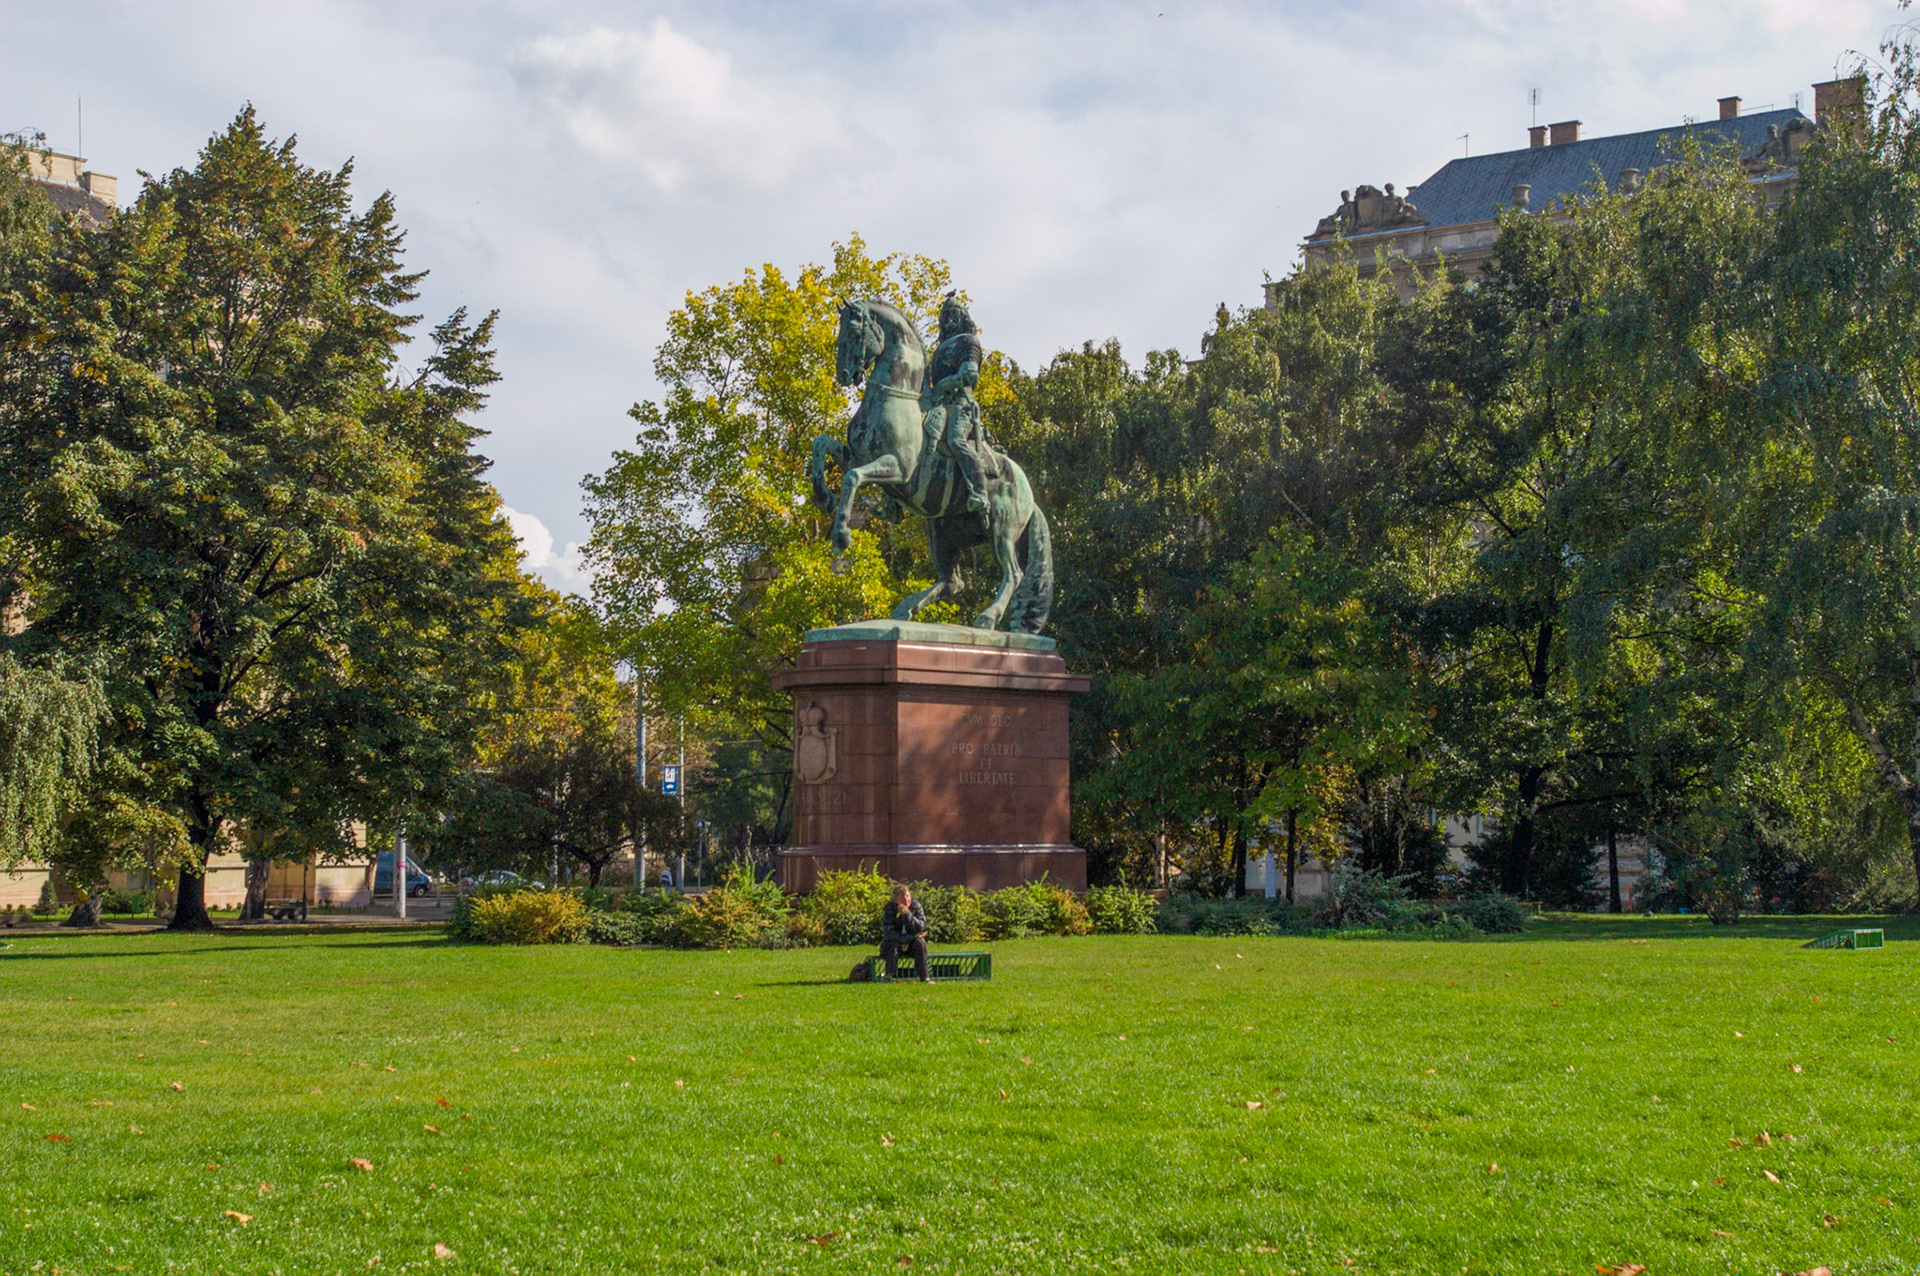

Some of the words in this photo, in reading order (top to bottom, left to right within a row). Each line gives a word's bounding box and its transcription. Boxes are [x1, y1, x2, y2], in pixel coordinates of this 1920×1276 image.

[990, 715, 1012, 727] DEO
[952, 743, 975, 756] PRO
[983, 743, 1021, 756] PATRIA
[980, 758, 992, 770] ET
[959, 772, 1015, 785] LIBERTATE
